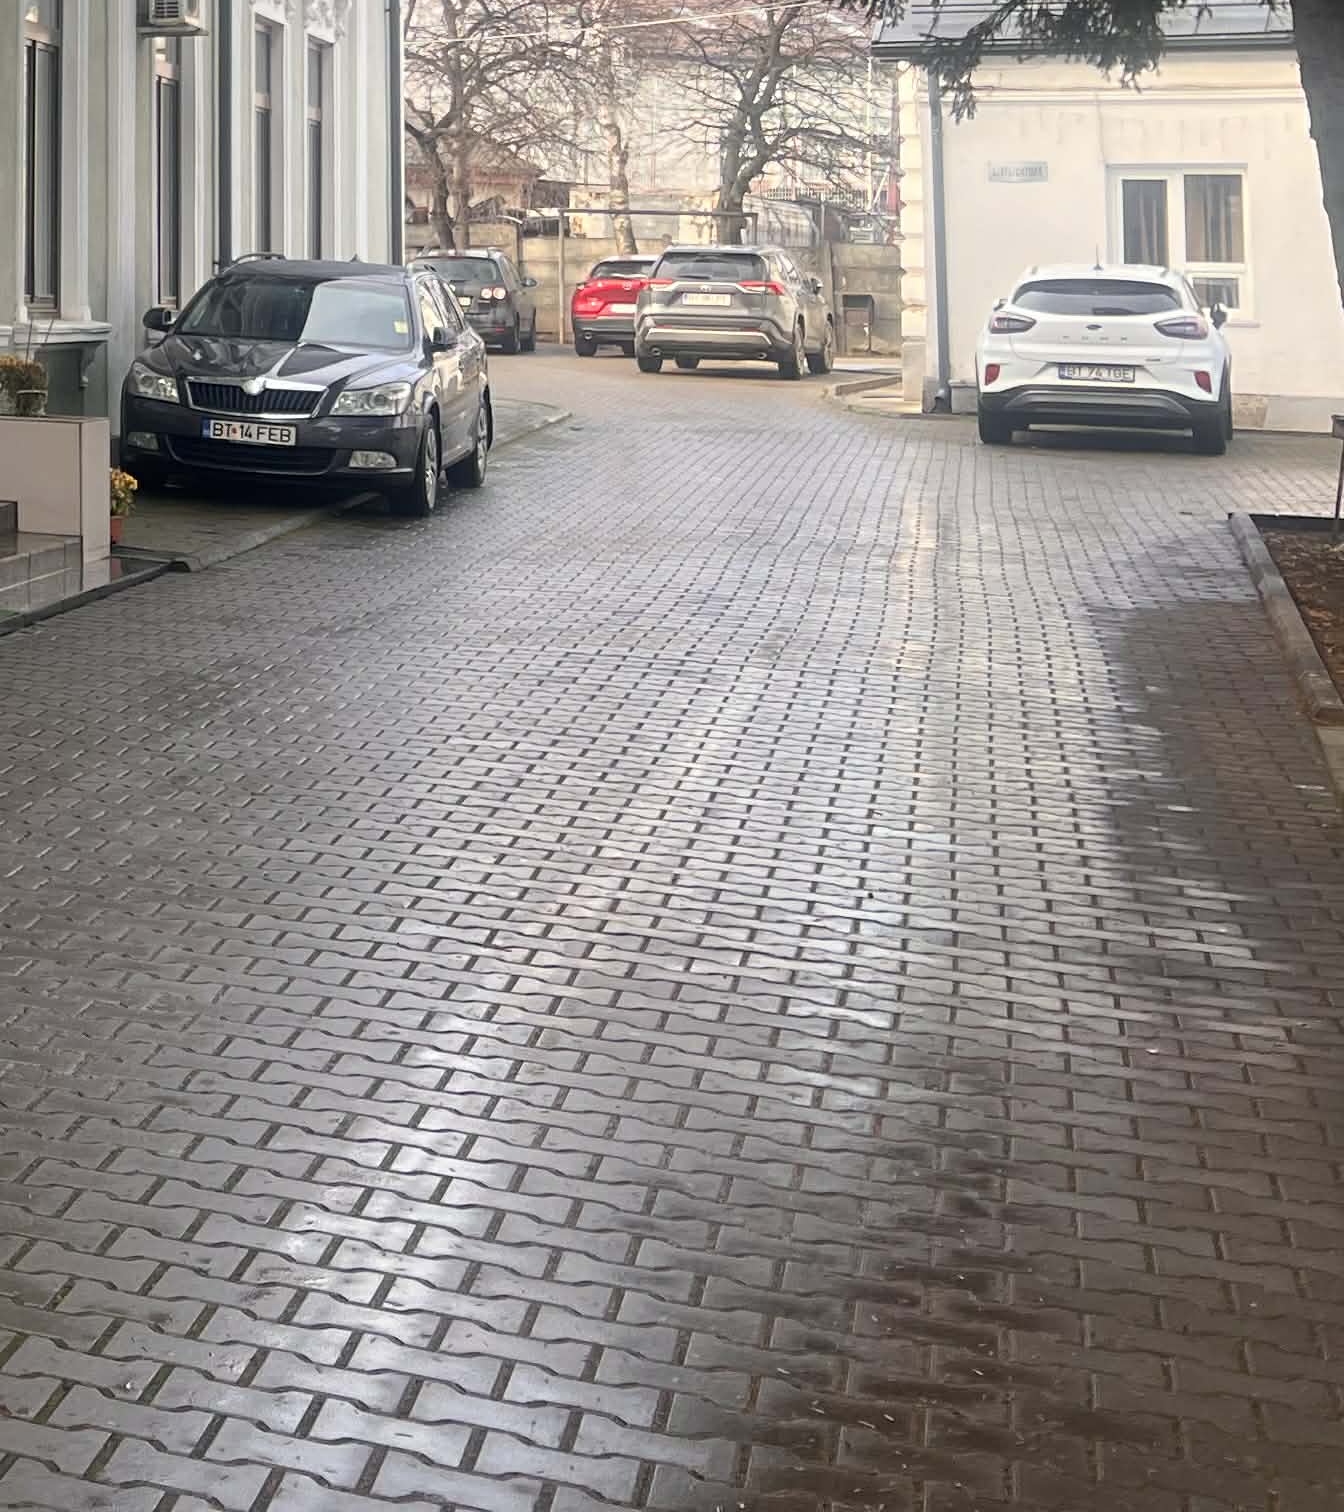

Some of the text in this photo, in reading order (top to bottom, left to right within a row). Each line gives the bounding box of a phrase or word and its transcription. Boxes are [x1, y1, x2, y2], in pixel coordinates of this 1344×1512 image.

[212, 422, 292, 443] BT 14 FEB
